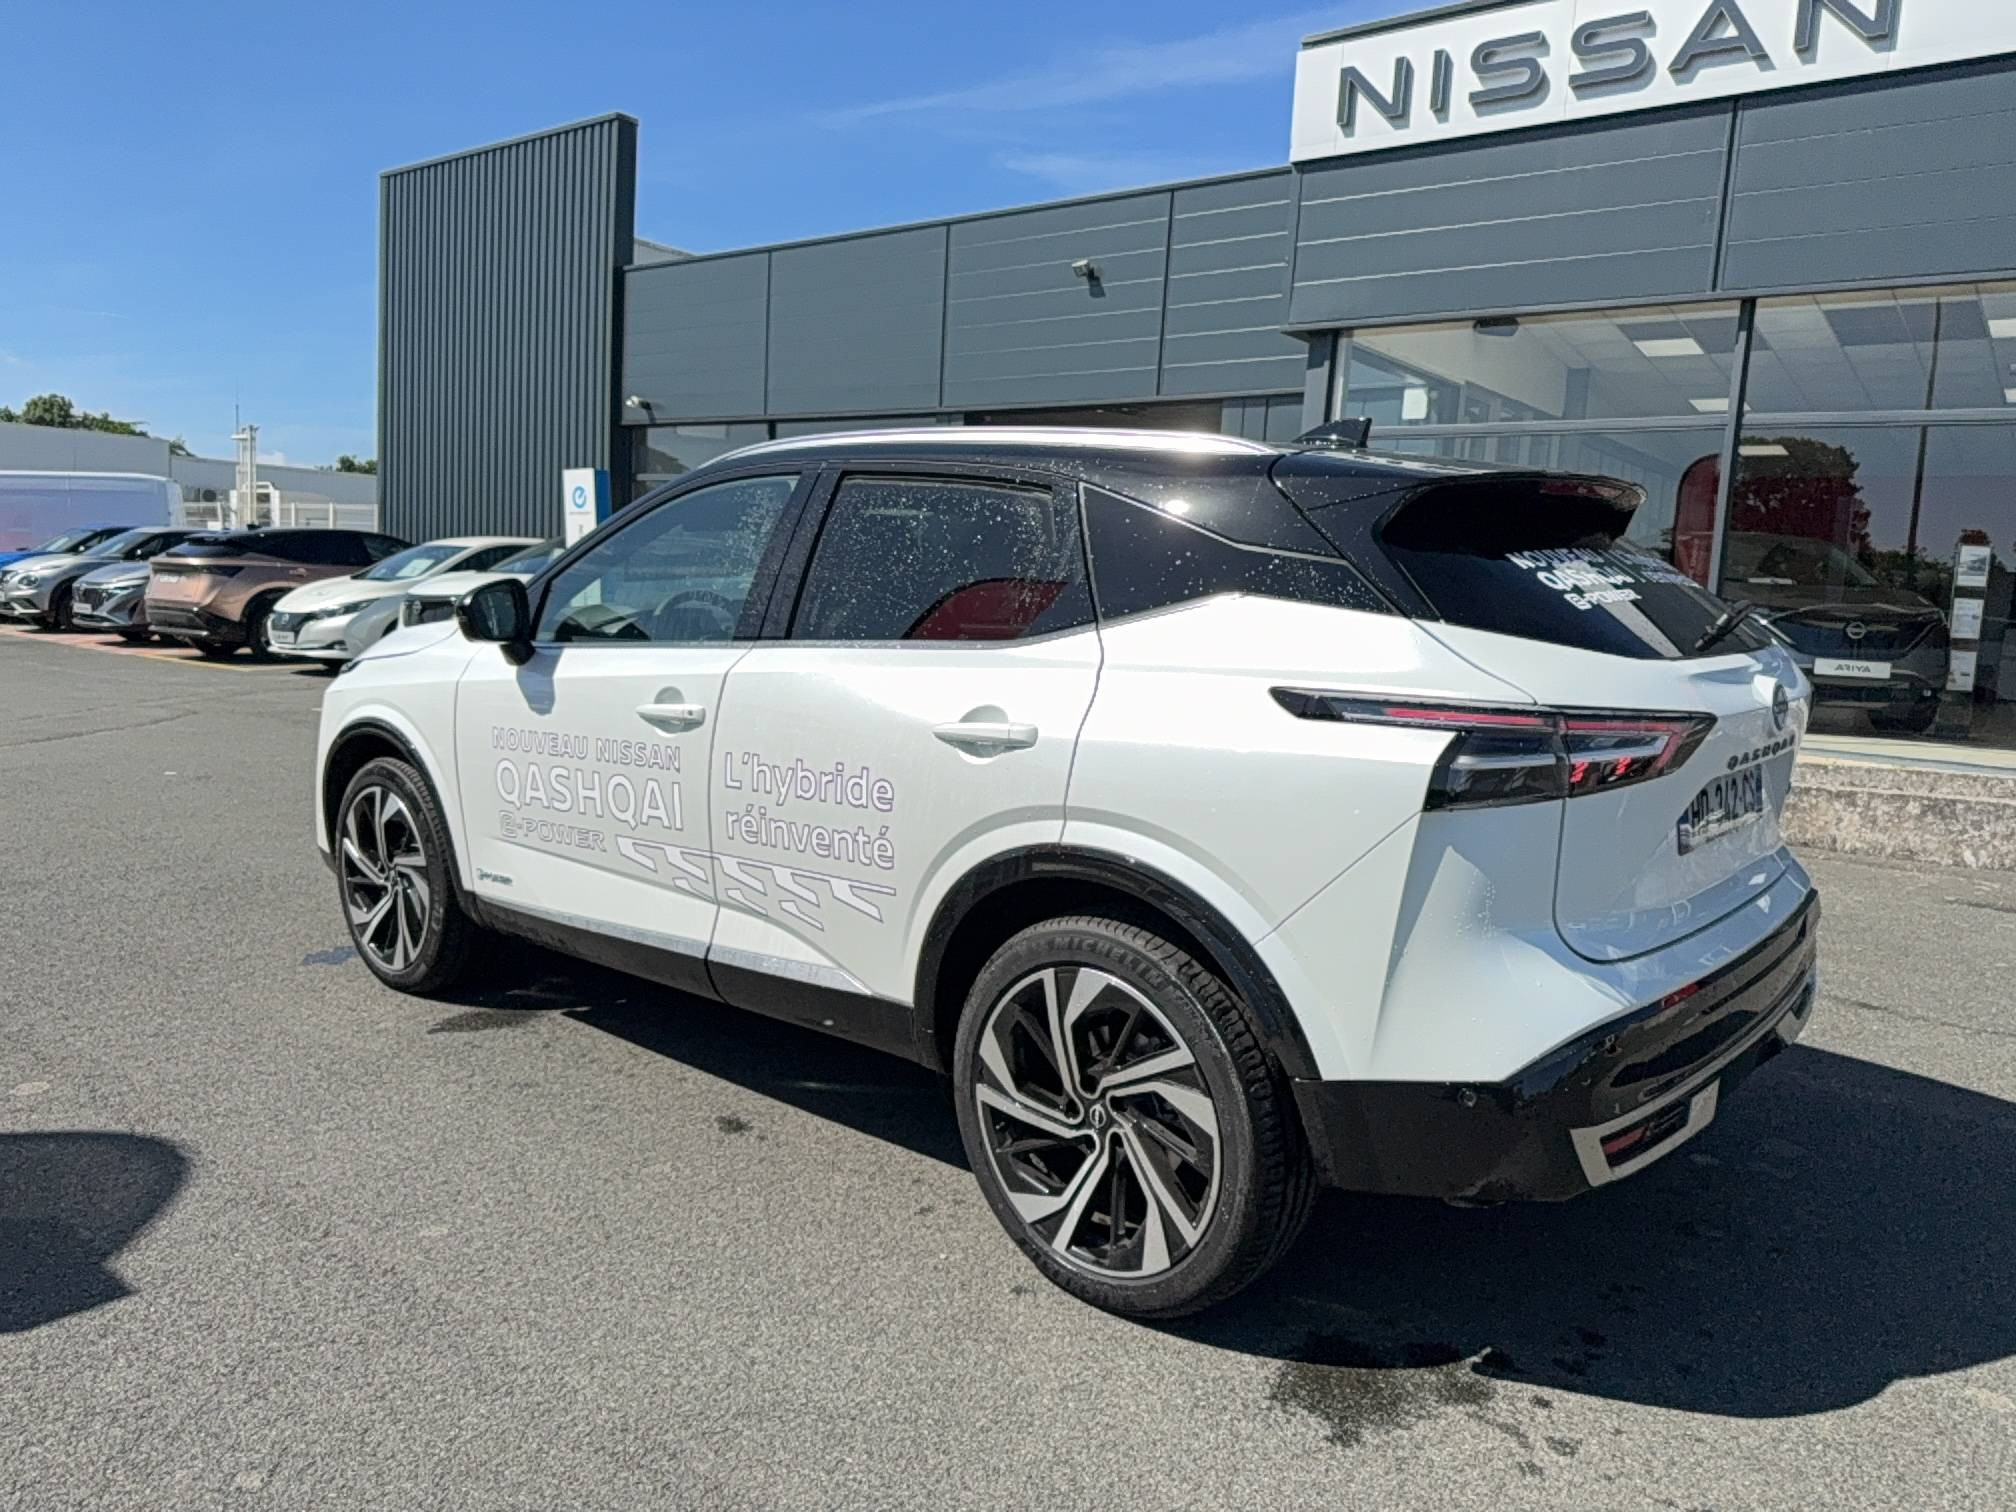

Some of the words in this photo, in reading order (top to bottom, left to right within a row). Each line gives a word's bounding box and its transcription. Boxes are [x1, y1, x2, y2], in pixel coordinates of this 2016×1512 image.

[1337, 0, 1898, 127] NISSAN
[1834, 663, 1871, 673] ARIYA
[492, 726, 588, 760] NOUVEAU
[596, 737, 681, 773] NISSAN
[496, 758, 684, 831] QASHQAI
[725, 752, 895, 812] L'hybride
[726, 803, 895, 870] réinventé
